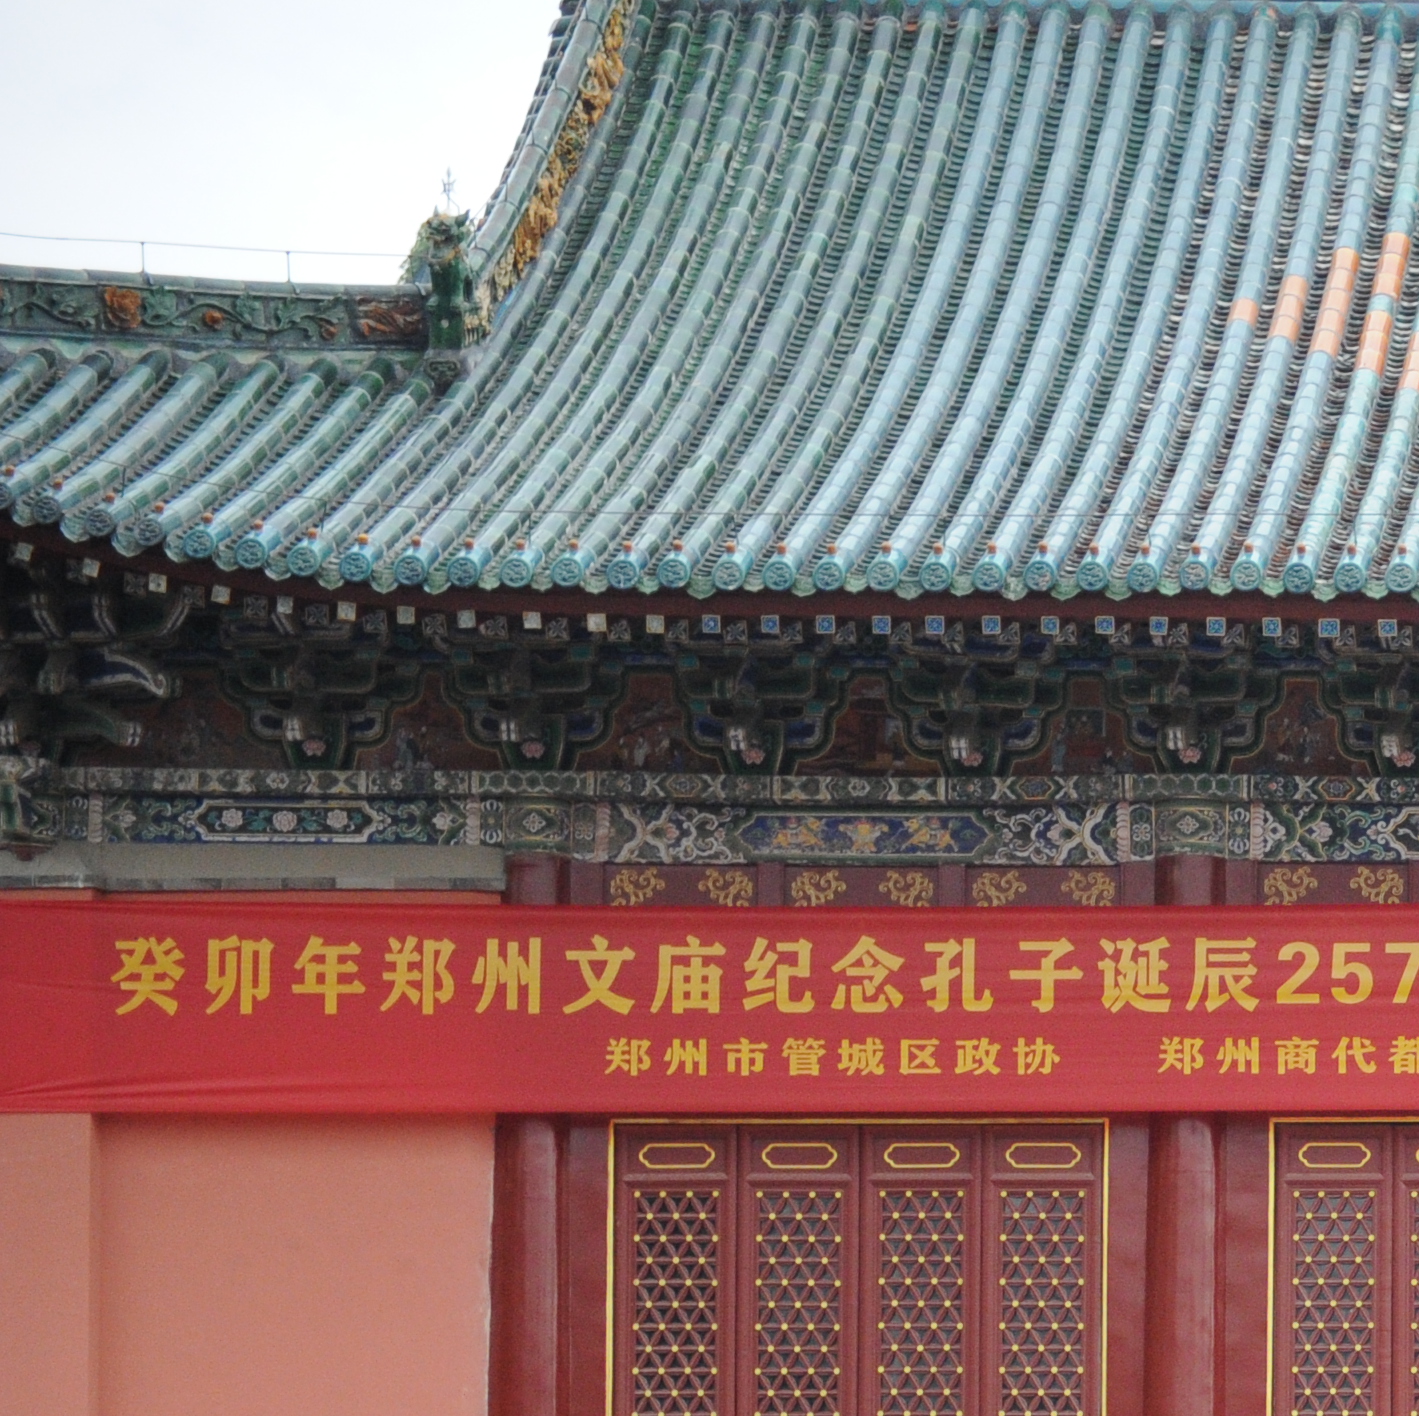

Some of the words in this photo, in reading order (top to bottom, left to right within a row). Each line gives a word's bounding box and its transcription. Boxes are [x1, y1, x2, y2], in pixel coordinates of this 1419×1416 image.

[605, 1036, 1061, 1077] 郑州市管城区政协
